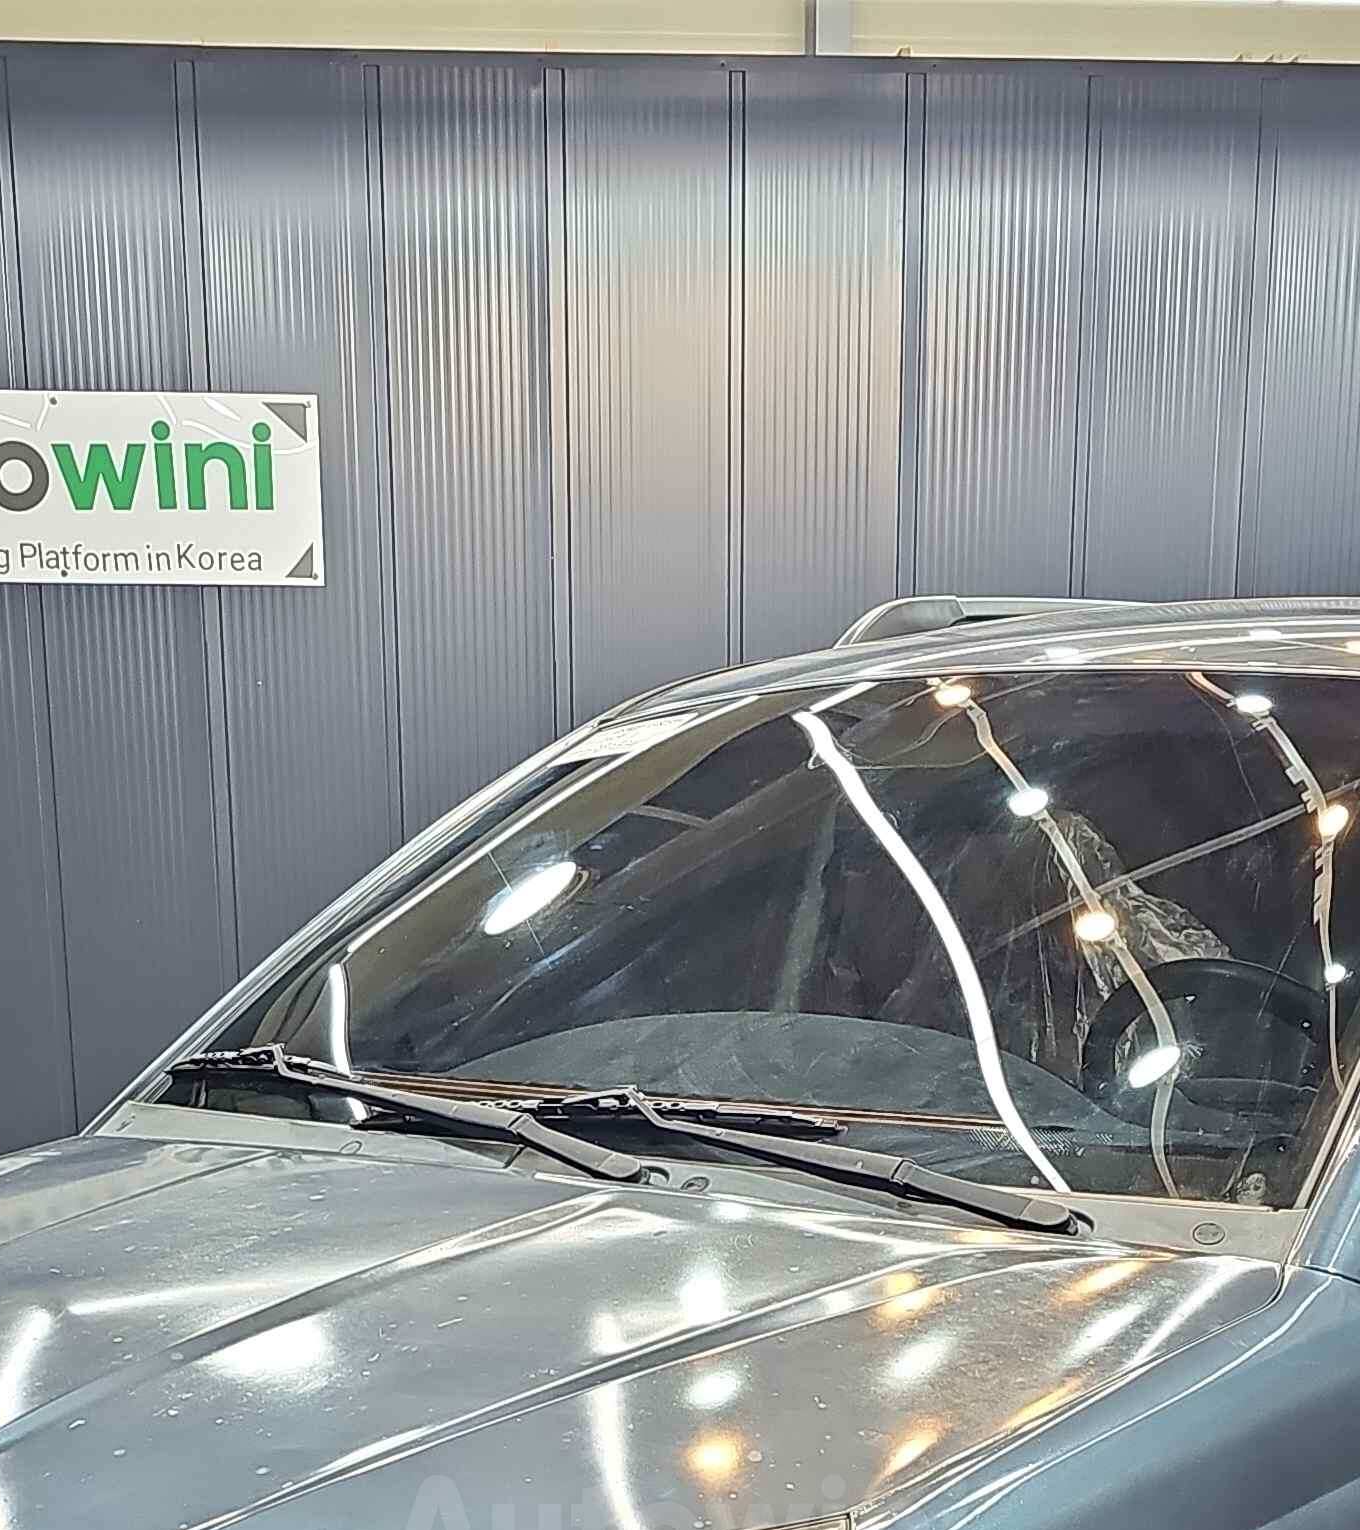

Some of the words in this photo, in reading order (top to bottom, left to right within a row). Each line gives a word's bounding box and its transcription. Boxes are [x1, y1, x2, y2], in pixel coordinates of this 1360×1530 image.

[19, 542, 139, 572] Platform
[145, 544, 171, 571] in
[176, 543, 263, 572] Korea
